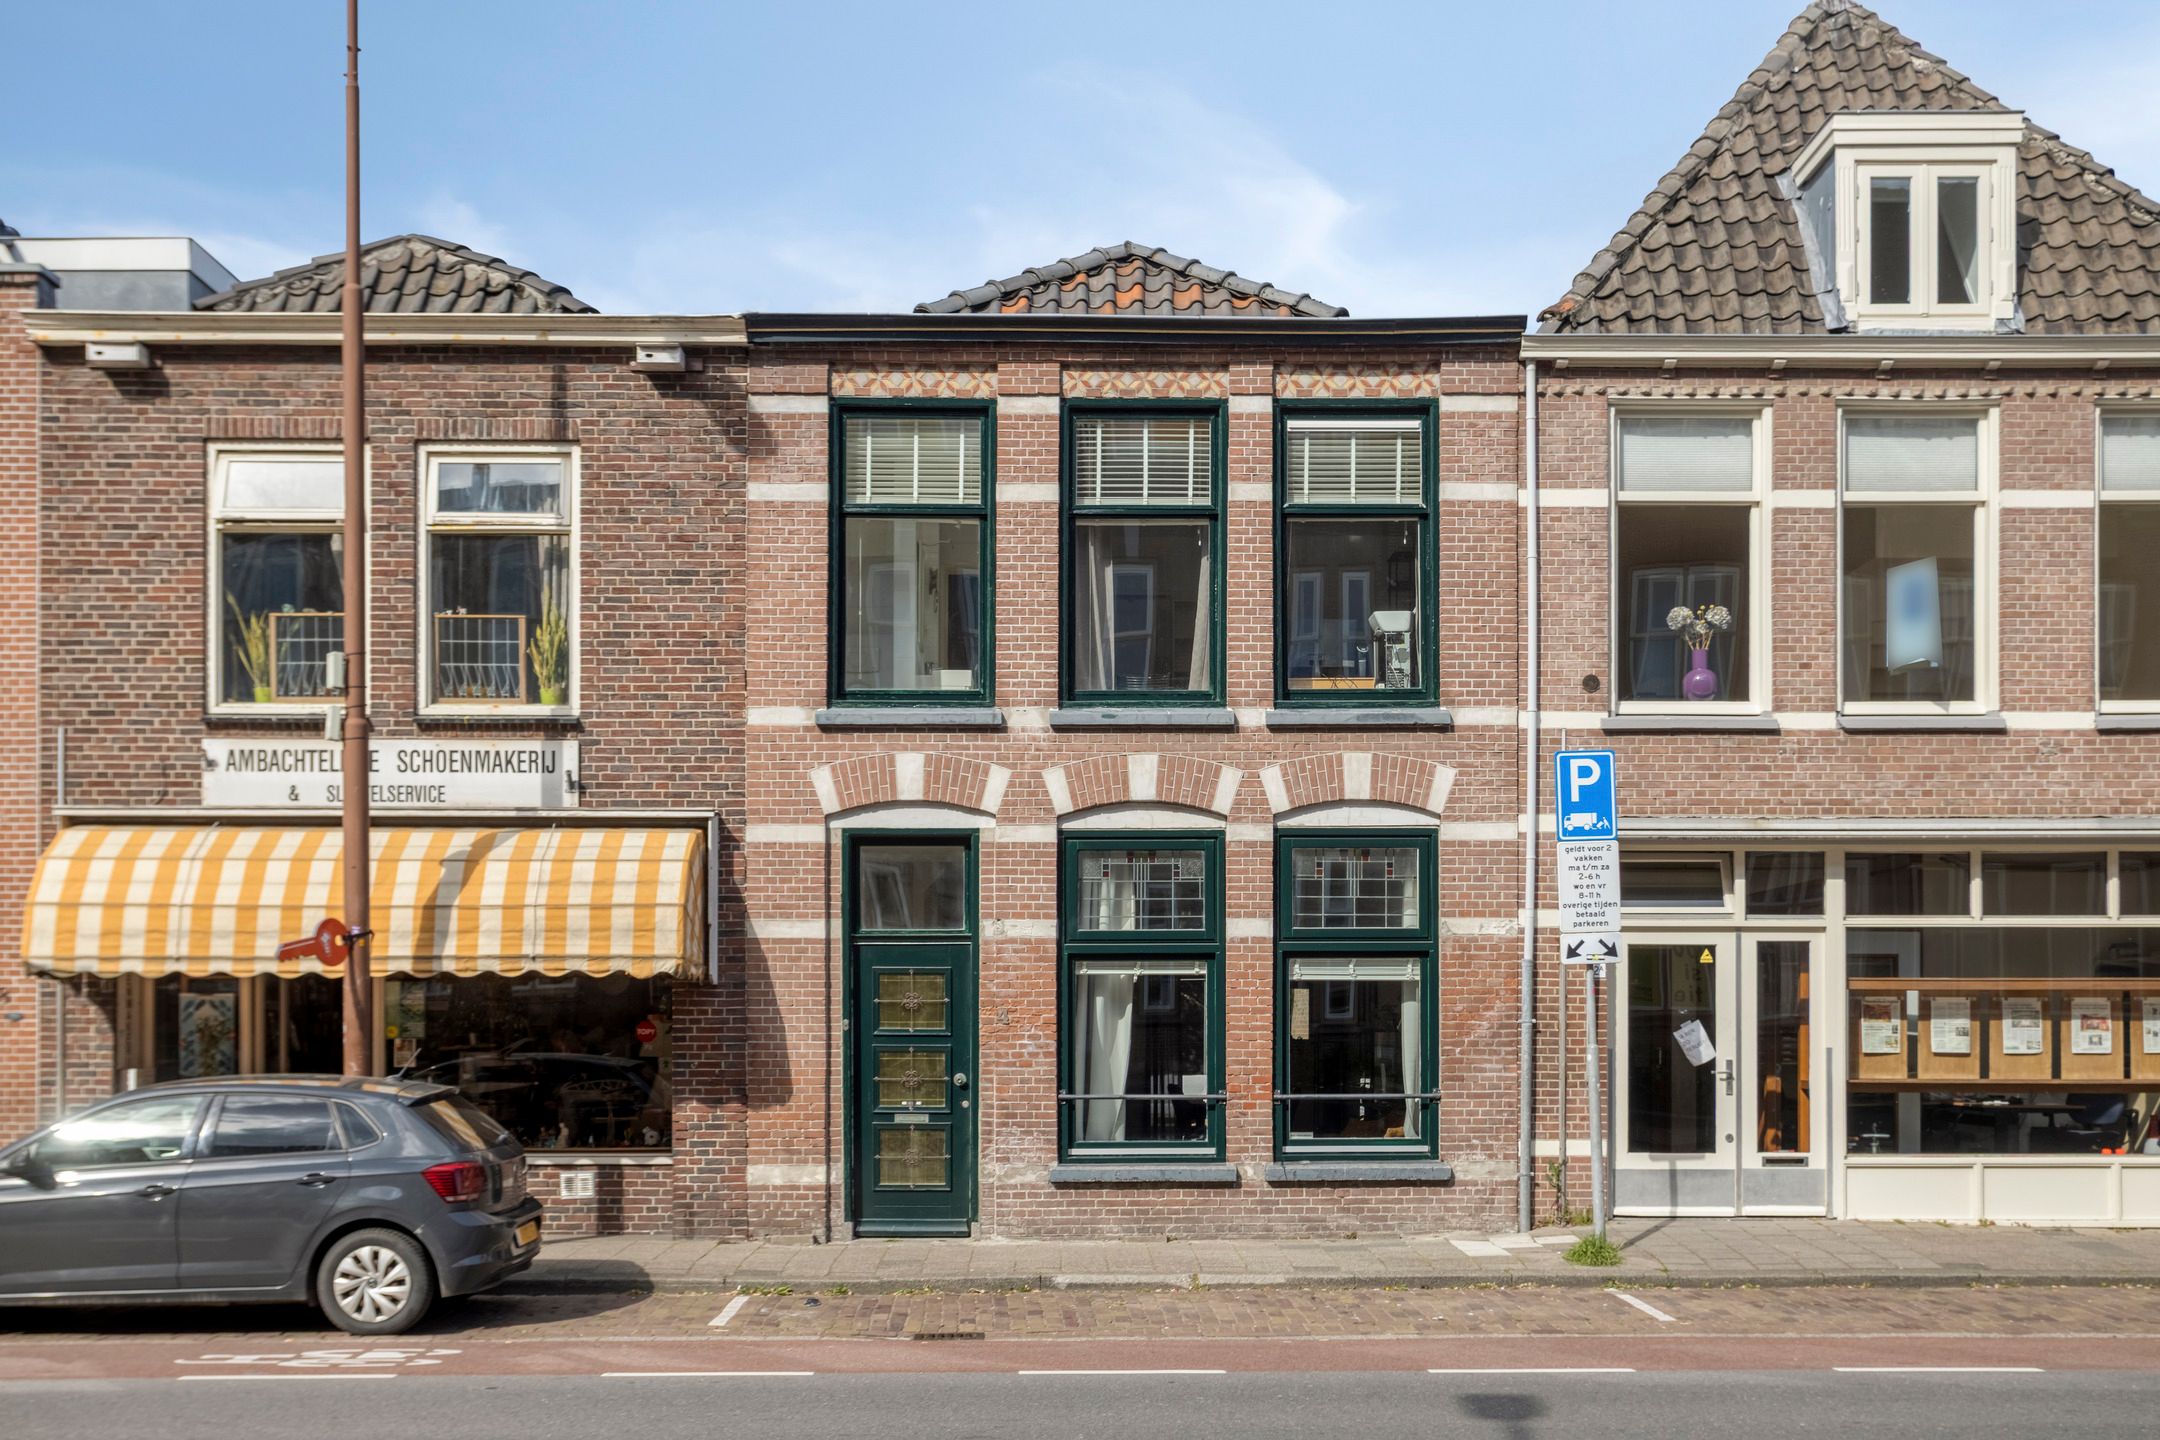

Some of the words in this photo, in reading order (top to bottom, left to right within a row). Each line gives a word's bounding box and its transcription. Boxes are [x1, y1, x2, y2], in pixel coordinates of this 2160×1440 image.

[225, 749, 380, 773] AMBACHTELE
[396, 749, 556, 774] SCHOENMAKERIJ
[1569, 758, 1601, 802] P
[288, 784, 300, 802] &
[326, 784, 447, 803] SLELSERVICE
[1564, 845, 1585, 855] geldt
[1606, 844, 1612, 852] 2
[1574, 854, 1603, 862] vakken
[1582, 863, 1599, 871] t/m
[1578, 872, 1594, 880] 2-6
[1578, 891, 1594, 899] 8-11
[1595, 891, 1601, 899] h
[1562, 901, 1592, 910] overige
[1594, 901, 1618, 910] tijden
[1573, 920, 1609, 928] parkeren
